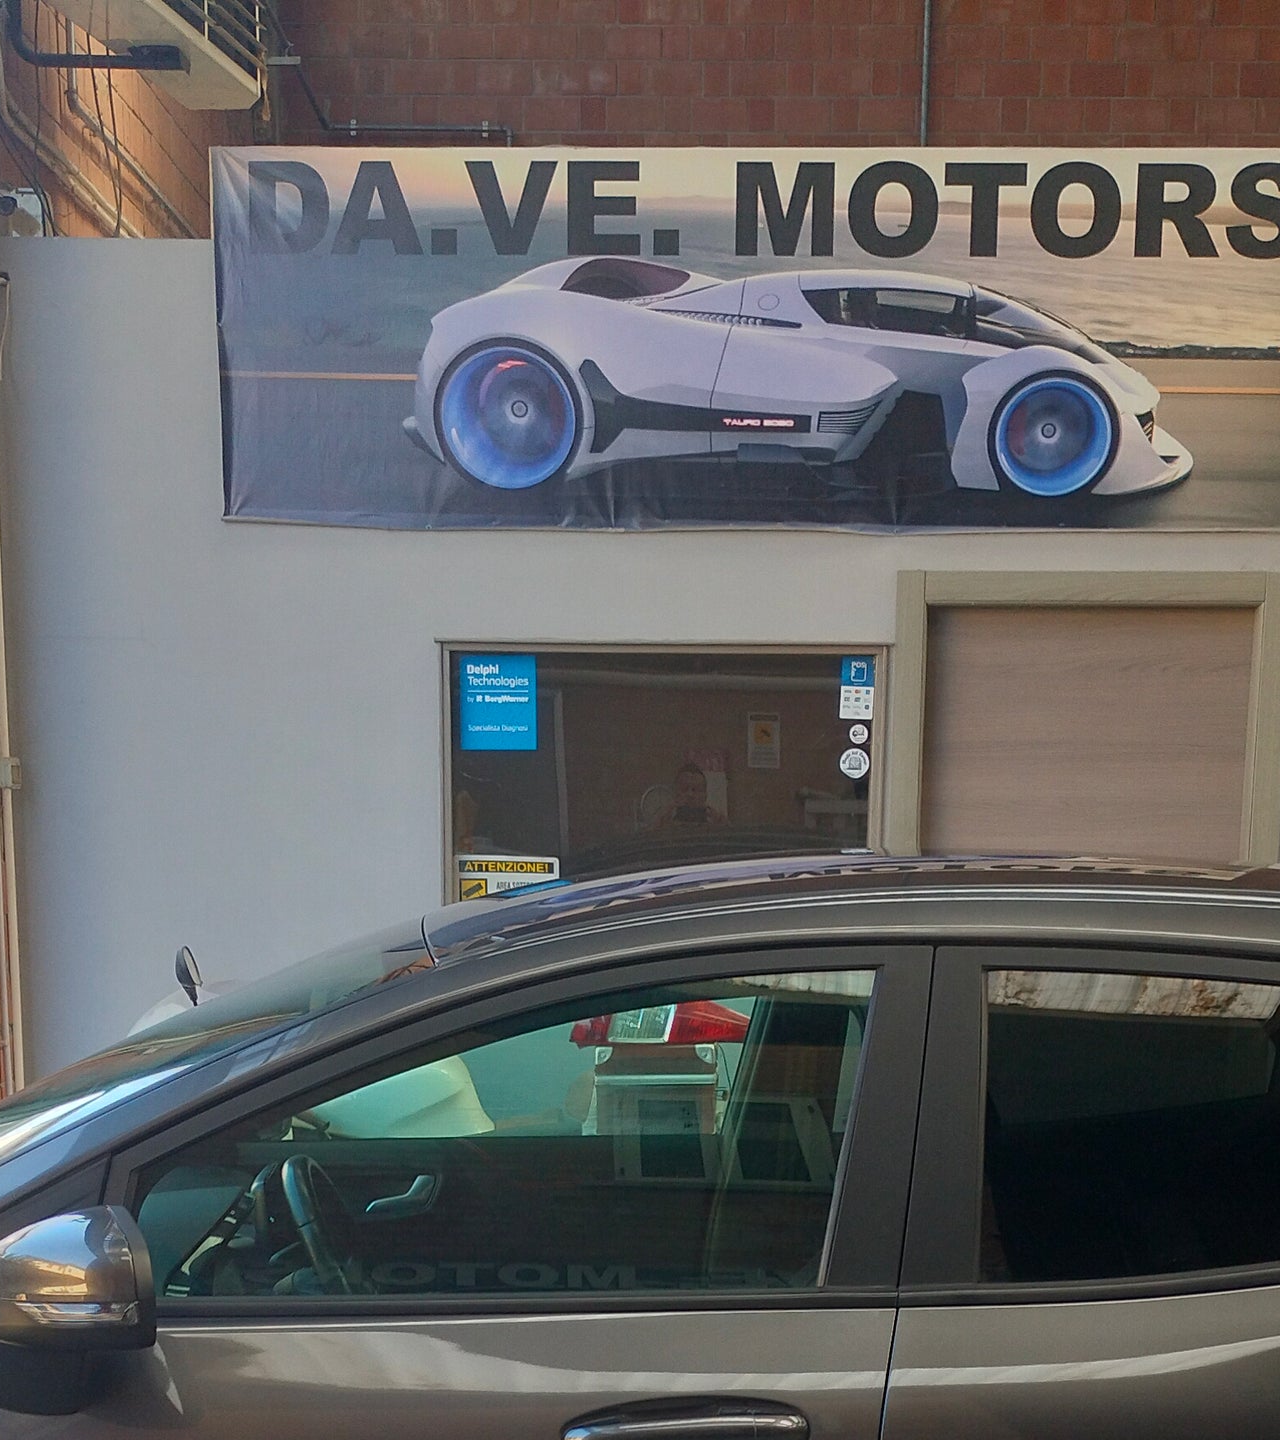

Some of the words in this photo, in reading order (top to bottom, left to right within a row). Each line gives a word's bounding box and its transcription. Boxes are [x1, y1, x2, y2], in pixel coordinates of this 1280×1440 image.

[247, 160, 680, 256] DA.VE.
[466, 664, 499, 677] Delphi
[467, 675, 529, 688] Technologies
[484, 694, 529, 704] BorgWarner
[464, 860, 549, 873] ATTENZIONE!
